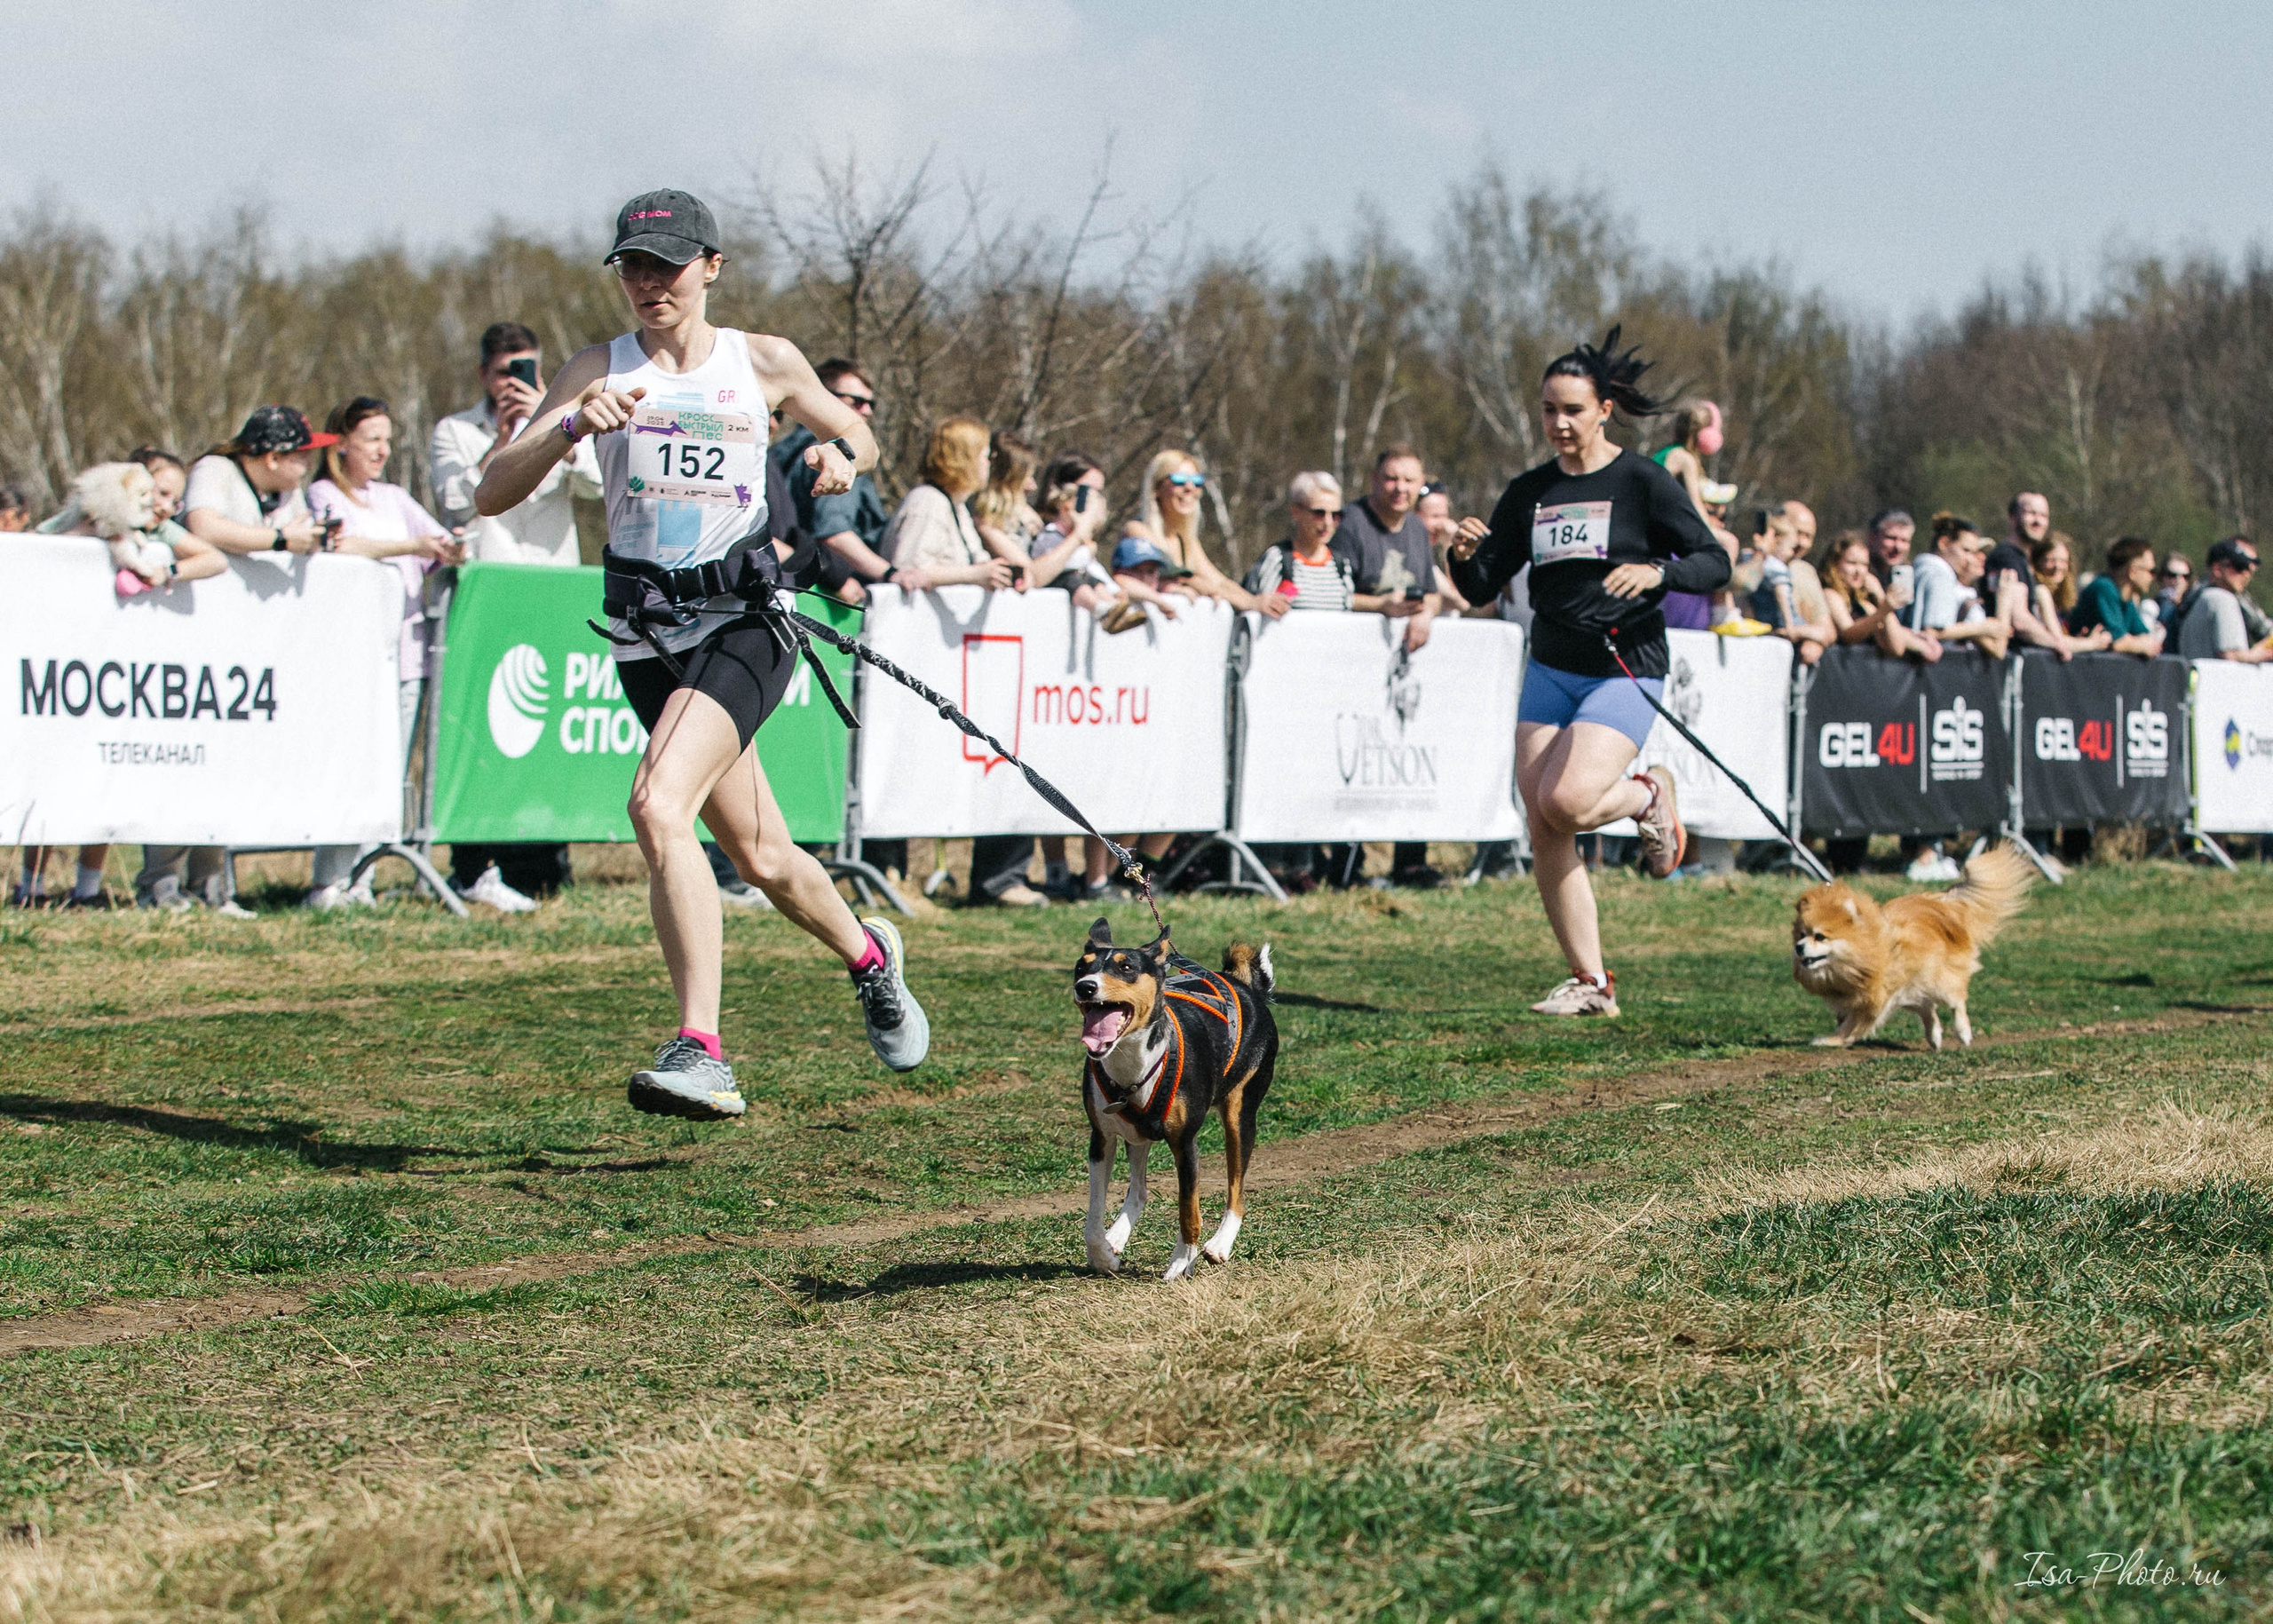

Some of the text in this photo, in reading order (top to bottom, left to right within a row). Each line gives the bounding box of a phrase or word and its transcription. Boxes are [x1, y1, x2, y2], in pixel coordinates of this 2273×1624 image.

[658, 443, 725, 480] 152
[1549, 523, 1588, 547] 184
[20, 658, 277, 721] МОСКВА24
[563, 652, 623, 700] РИ
[1033, 685, 1149, 725] mos.ru
[98, 741, 206, 765] ТЕЛЕКАНАЛ
[1819, 722, 1915, 767] GEL4U
[2035, 717, 2112, 761] GEL4U
